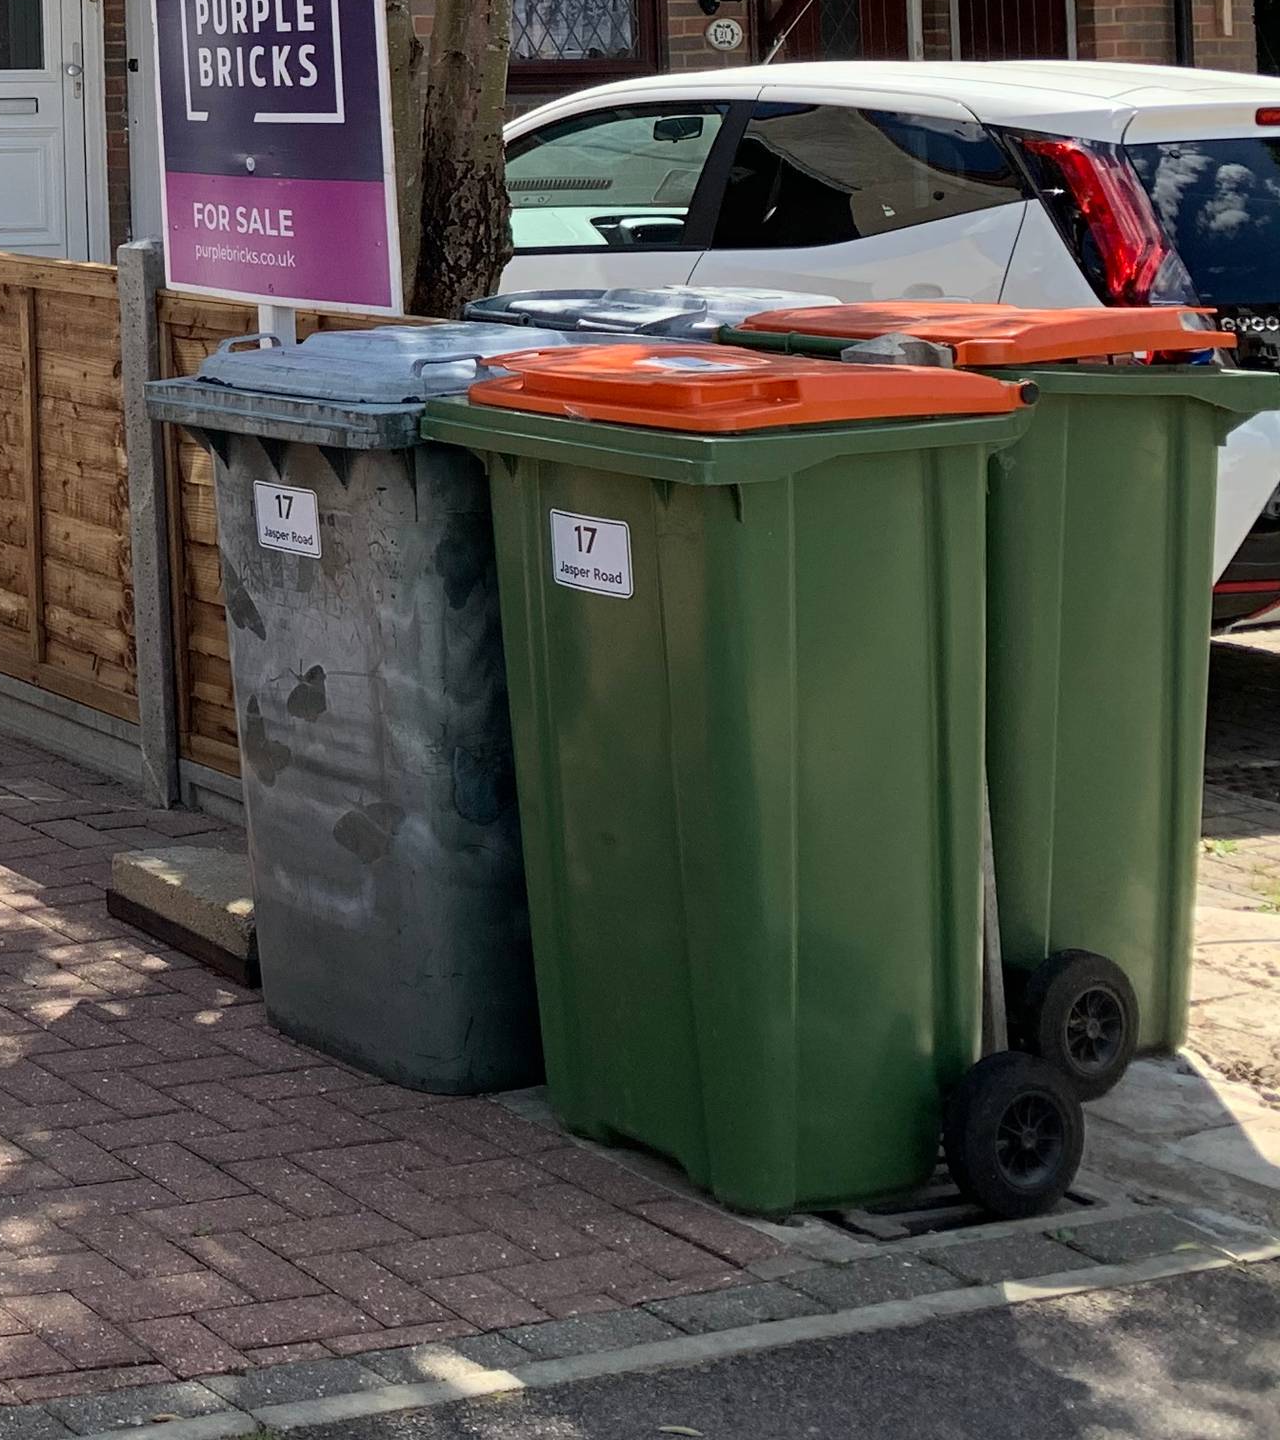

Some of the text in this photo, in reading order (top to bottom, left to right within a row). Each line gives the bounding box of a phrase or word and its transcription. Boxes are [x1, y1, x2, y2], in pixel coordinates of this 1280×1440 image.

[198, 44, 318, 87] BRICKS
[193, 202, 294, 237] FOR SALE
[195, 243, 296, 268] purplebricks.co.uk
[275, 494, 293, 519] 17
[264, 526, 313, 545] Jasper Road
[574, 525, 597, 554] 17
[560, 561, 622, 584] Jasper Road
